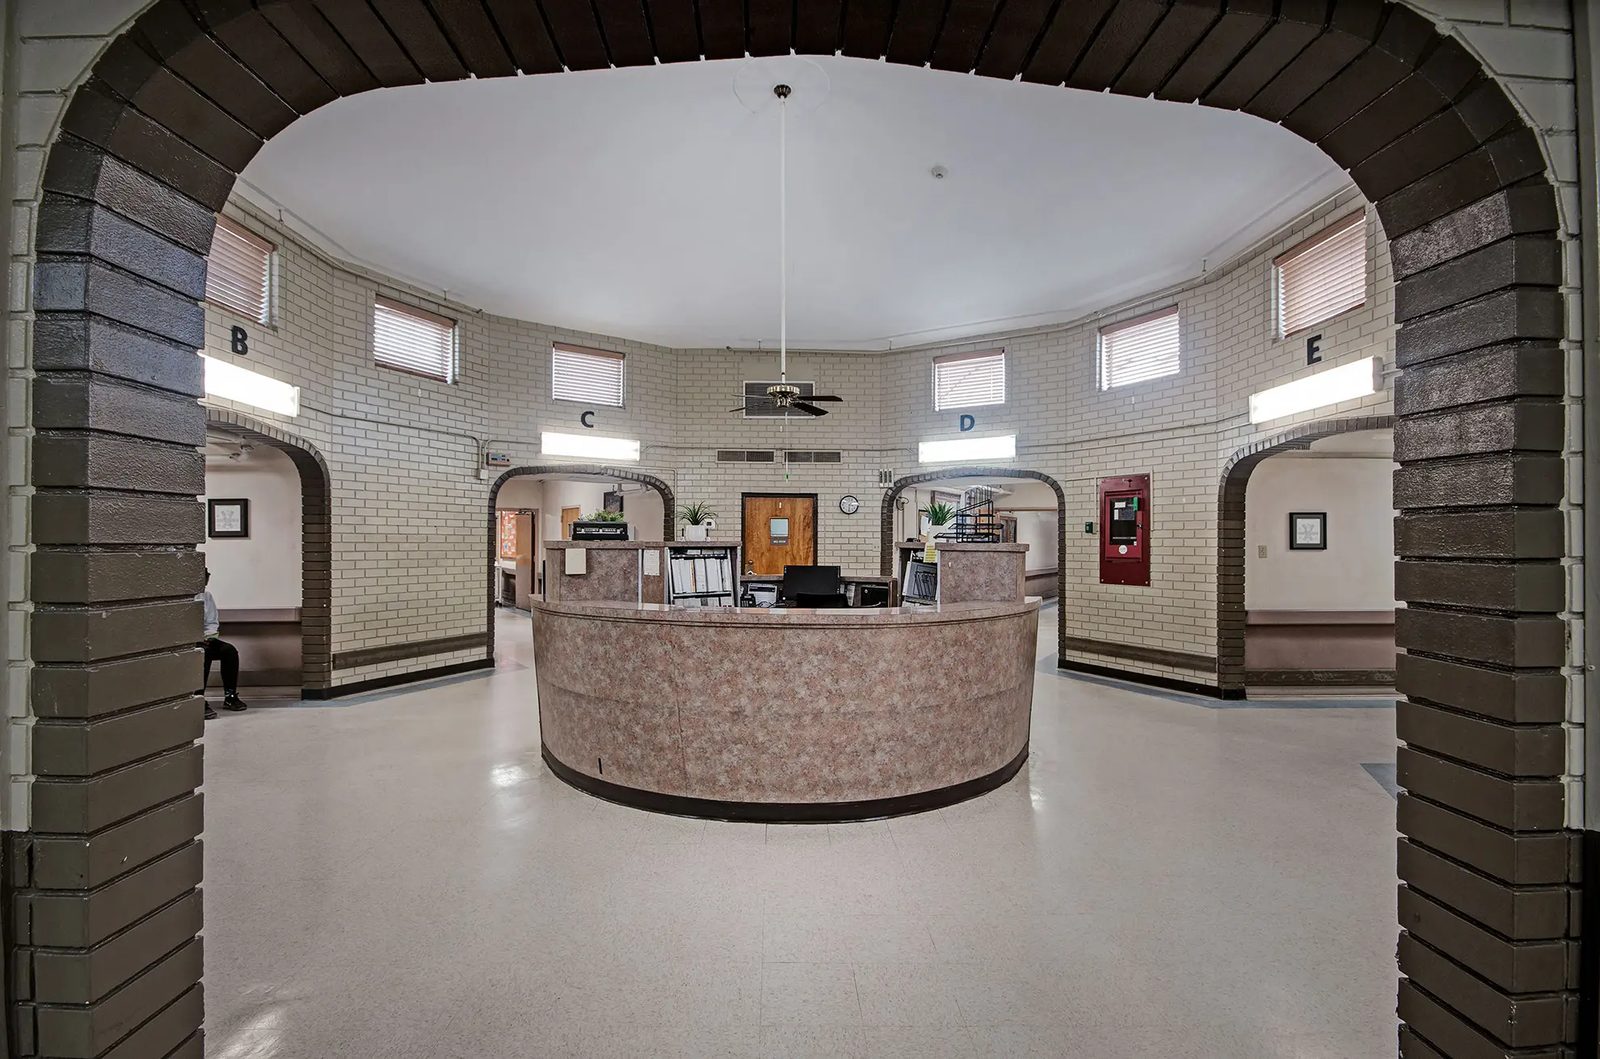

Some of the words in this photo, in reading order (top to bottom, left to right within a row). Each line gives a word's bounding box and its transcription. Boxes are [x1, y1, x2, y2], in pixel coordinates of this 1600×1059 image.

[231, 325, 249, 355] B
[1307, 334, 1322, 365] E
[581, 411, 595, 428] C
[960, 415, 975, 431] D
